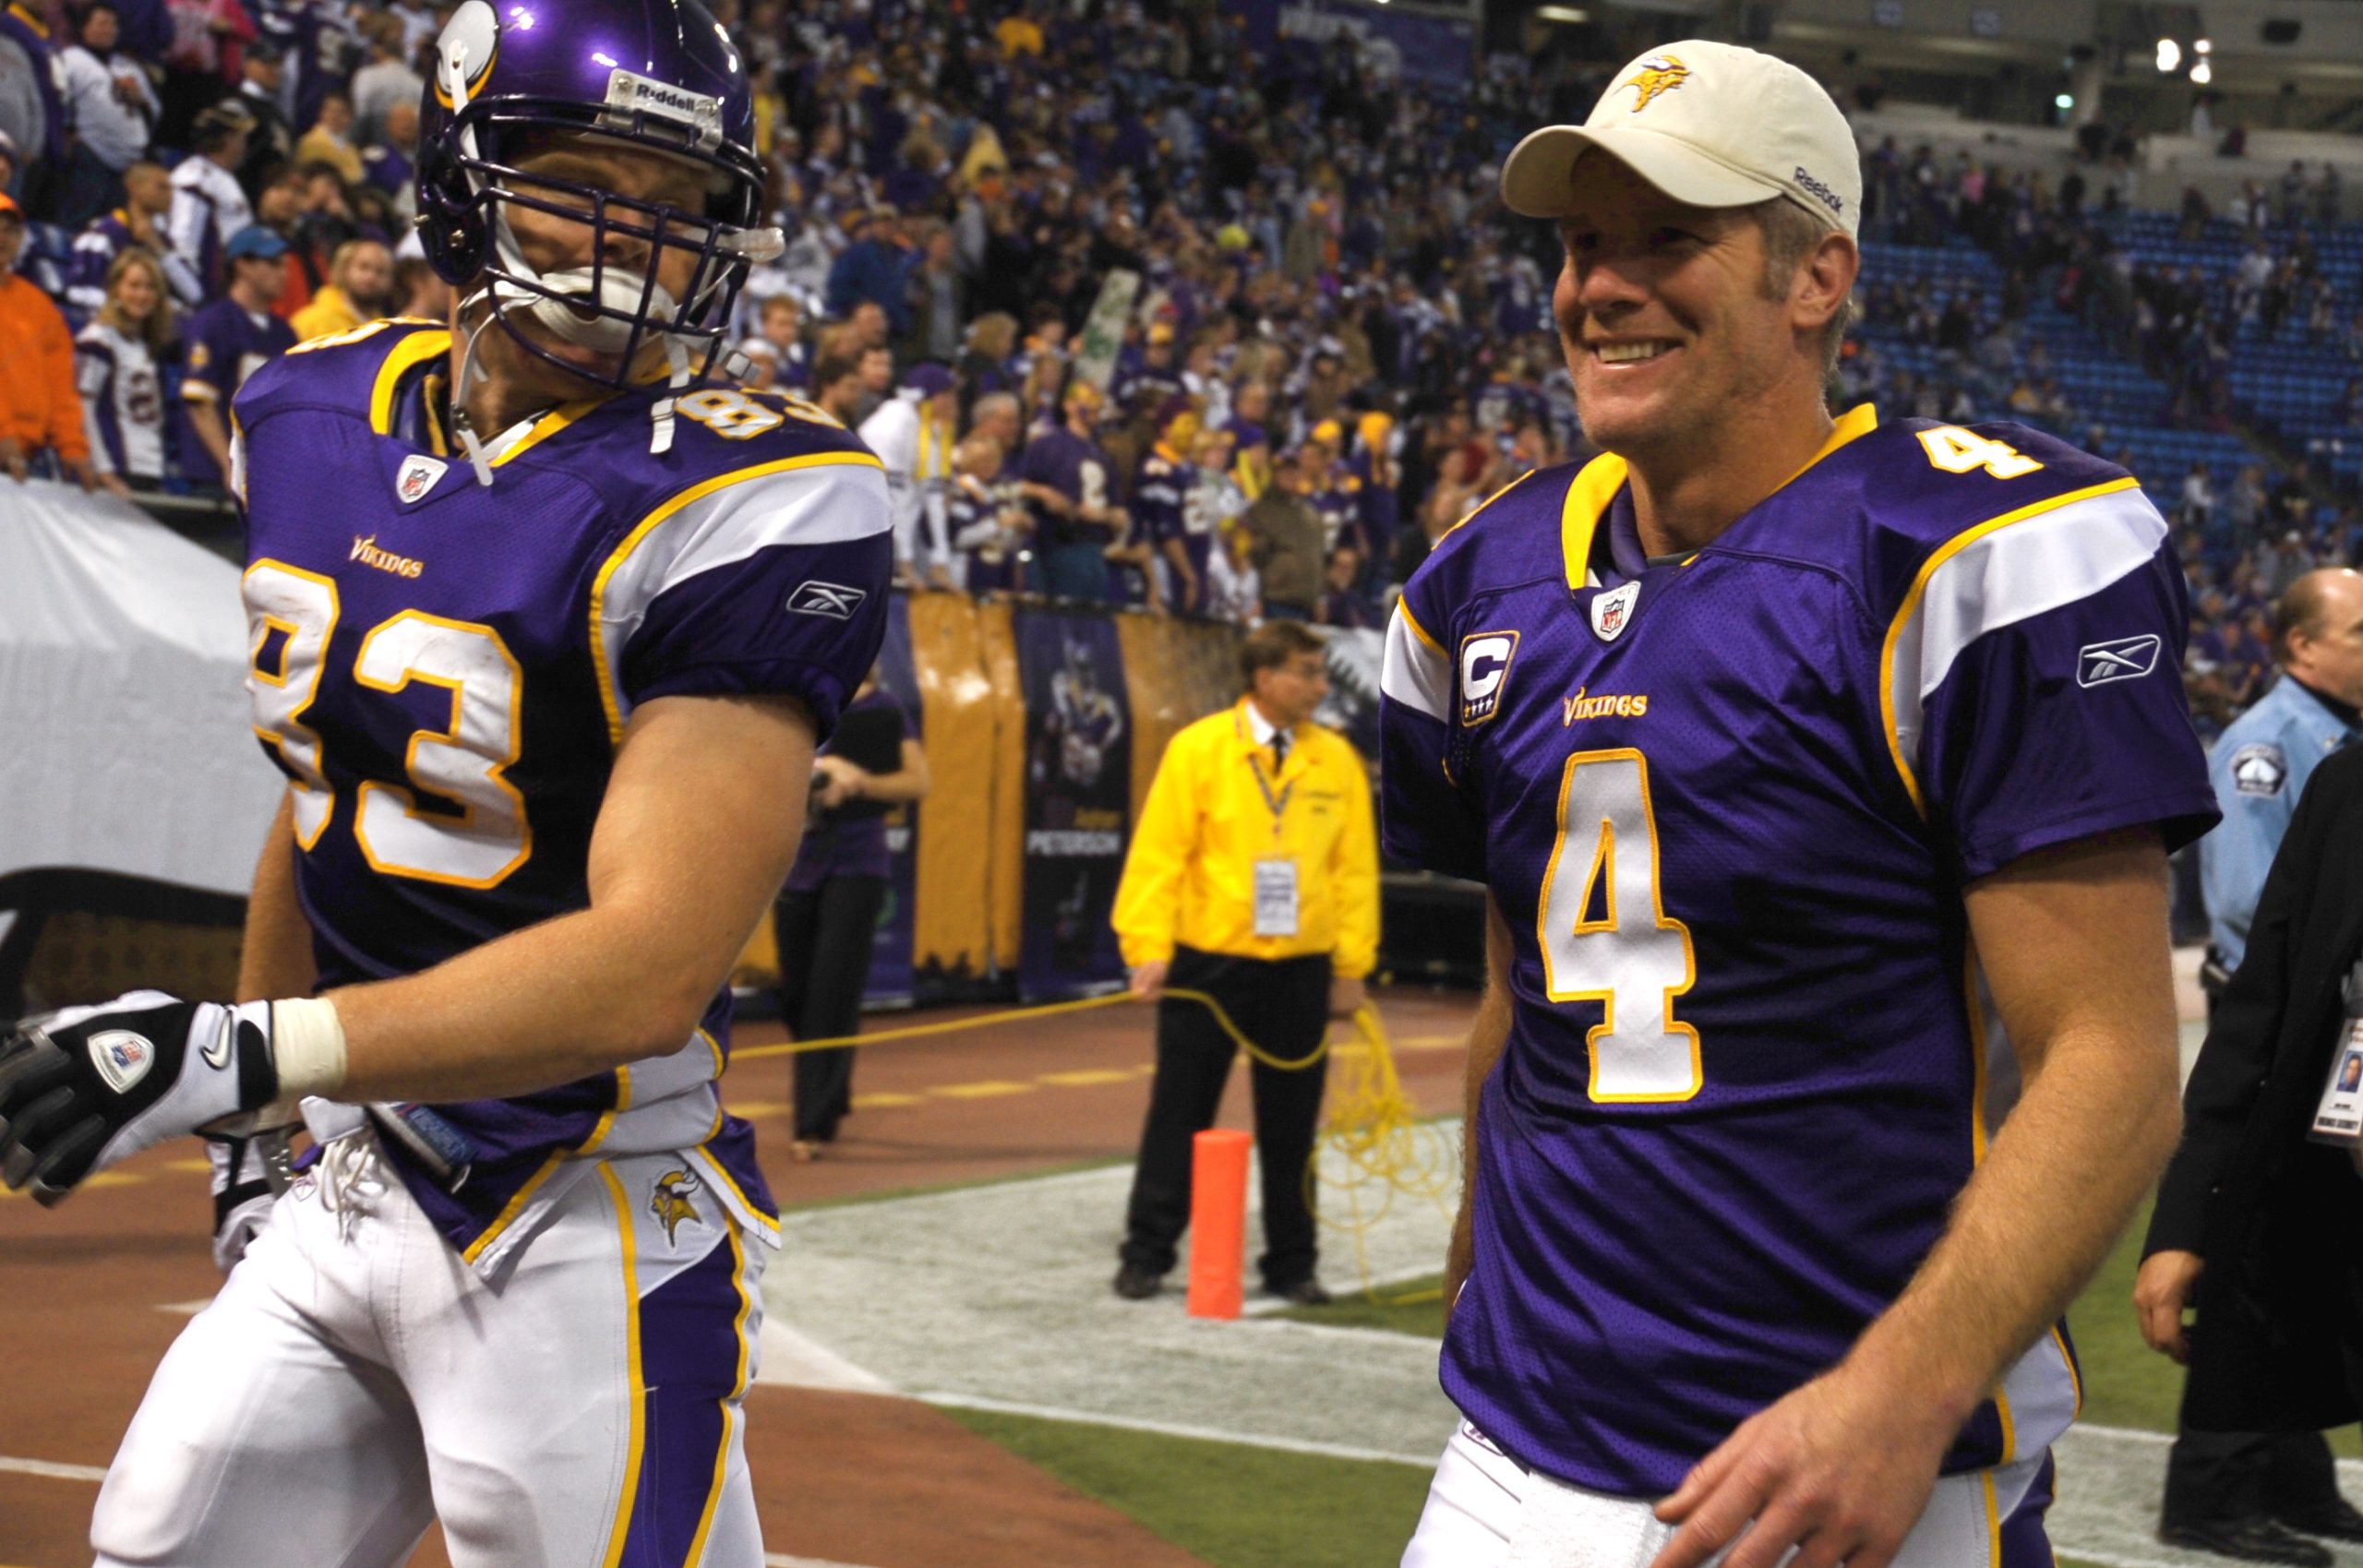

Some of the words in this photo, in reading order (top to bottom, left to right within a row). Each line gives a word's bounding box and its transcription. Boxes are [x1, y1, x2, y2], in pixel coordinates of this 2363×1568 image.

[635, 83, 696, 113] Riddell
[1793, 165, 1843, 214] Reebok
[1915, 425, 2045, 480] 4
[1463, 638, 1511, 700] C
[241, 557, 534, 890] 83
[1537, 747, 1703, 1103] 4
